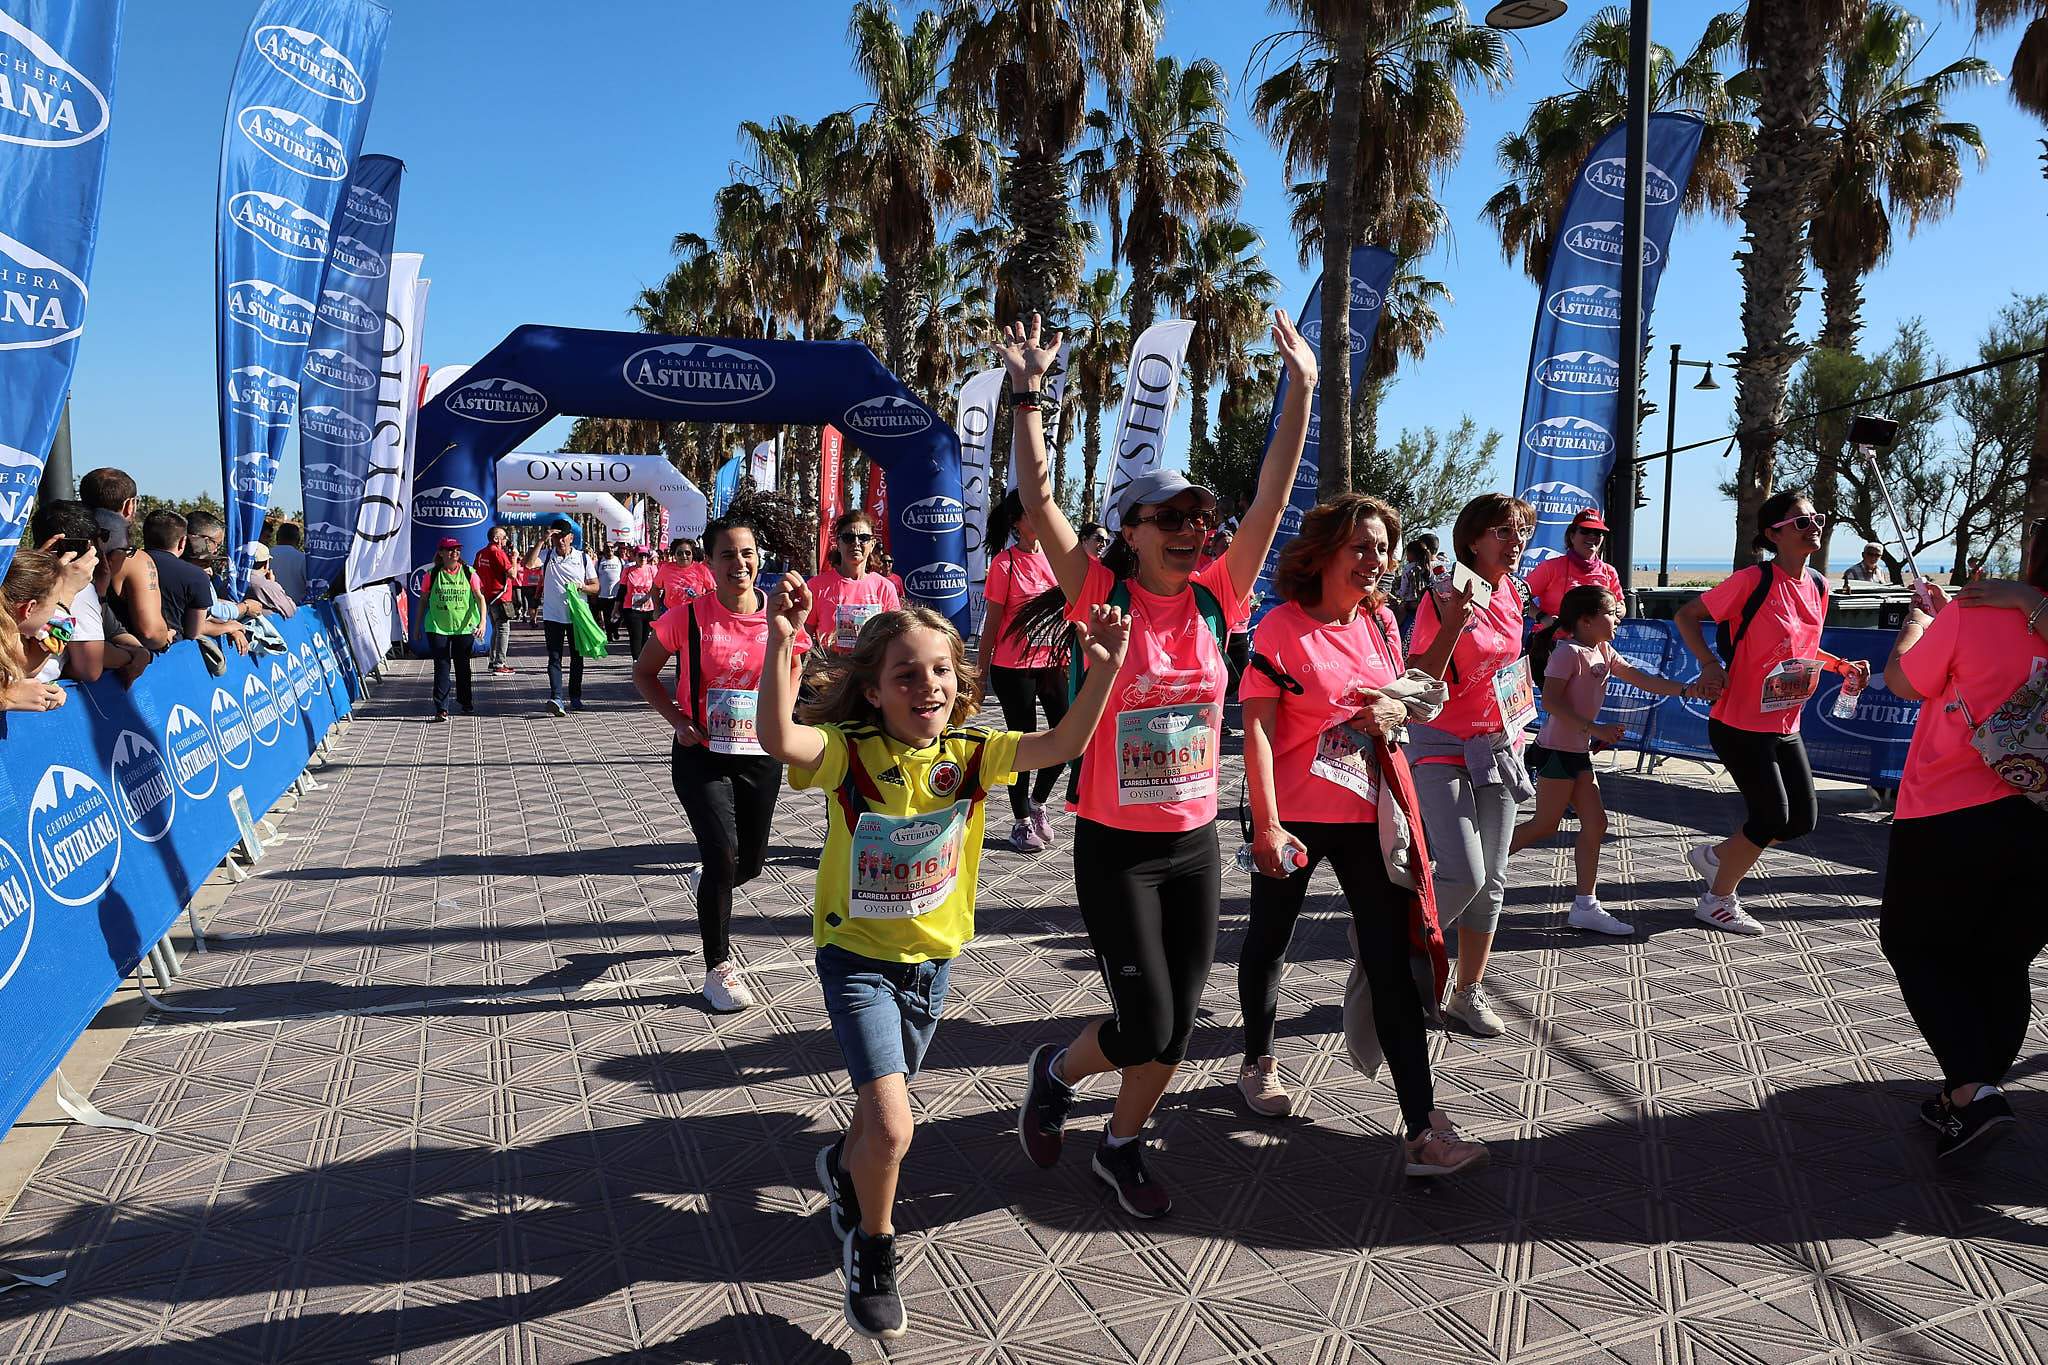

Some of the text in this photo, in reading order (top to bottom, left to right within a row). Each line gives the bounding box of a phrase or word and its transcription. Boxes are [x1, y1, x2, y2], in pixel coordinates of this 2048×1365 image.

[261, 33, 357, 101] ASTURIANA
[1553, 296, 1621, 320] ASTURIA
[304, 355, 370, 388] ASTURIANA
[658, 358, 760, 371] CENTRAL LECHERA
[634, 358, 765, 391] ASTURIANA
[1540, 364, 1620, 388] ASTURIANA
[451, 396, 541, 414] ASTURIANA
[301, 412, 366, 442] ASTURIANA
[851, 411, 928, 428] ASTURIANA
[1530, 429, 1607, 453] ASTURIANA
[526, 460, 632, 483] OYSHO
[659, 484, 690, 492] OYSHO
[412, 502, 484, 520] ASTURIANA
[675, 525, 704, 533] OYSHO
[1302, 660, 1340, 673] OYSHO
[170, 741, 217, 786] ASTURIANA
[1123, 778, 1151, 787] CARRERA
[1151, 778, 1160, 786] DE
[117, 770, 173, 827] ASTURIANA
[1129, 789, 1164, 799] OYSHO
[46, 811, 77, 838] CENTRAL
[893, 828, 940, 843] ASTURIANA
[37, 810, 118, 889] ASTURIANA
[857, 891, 889, 901] CARRERA
[890, 893, 900, 901] DE
[901, 891, 911, 900] LA
[911, 887, 932, 899] MUJER
[904, 880, 926, 892] 1984
[864, 903, 905, 913] OYSHO
